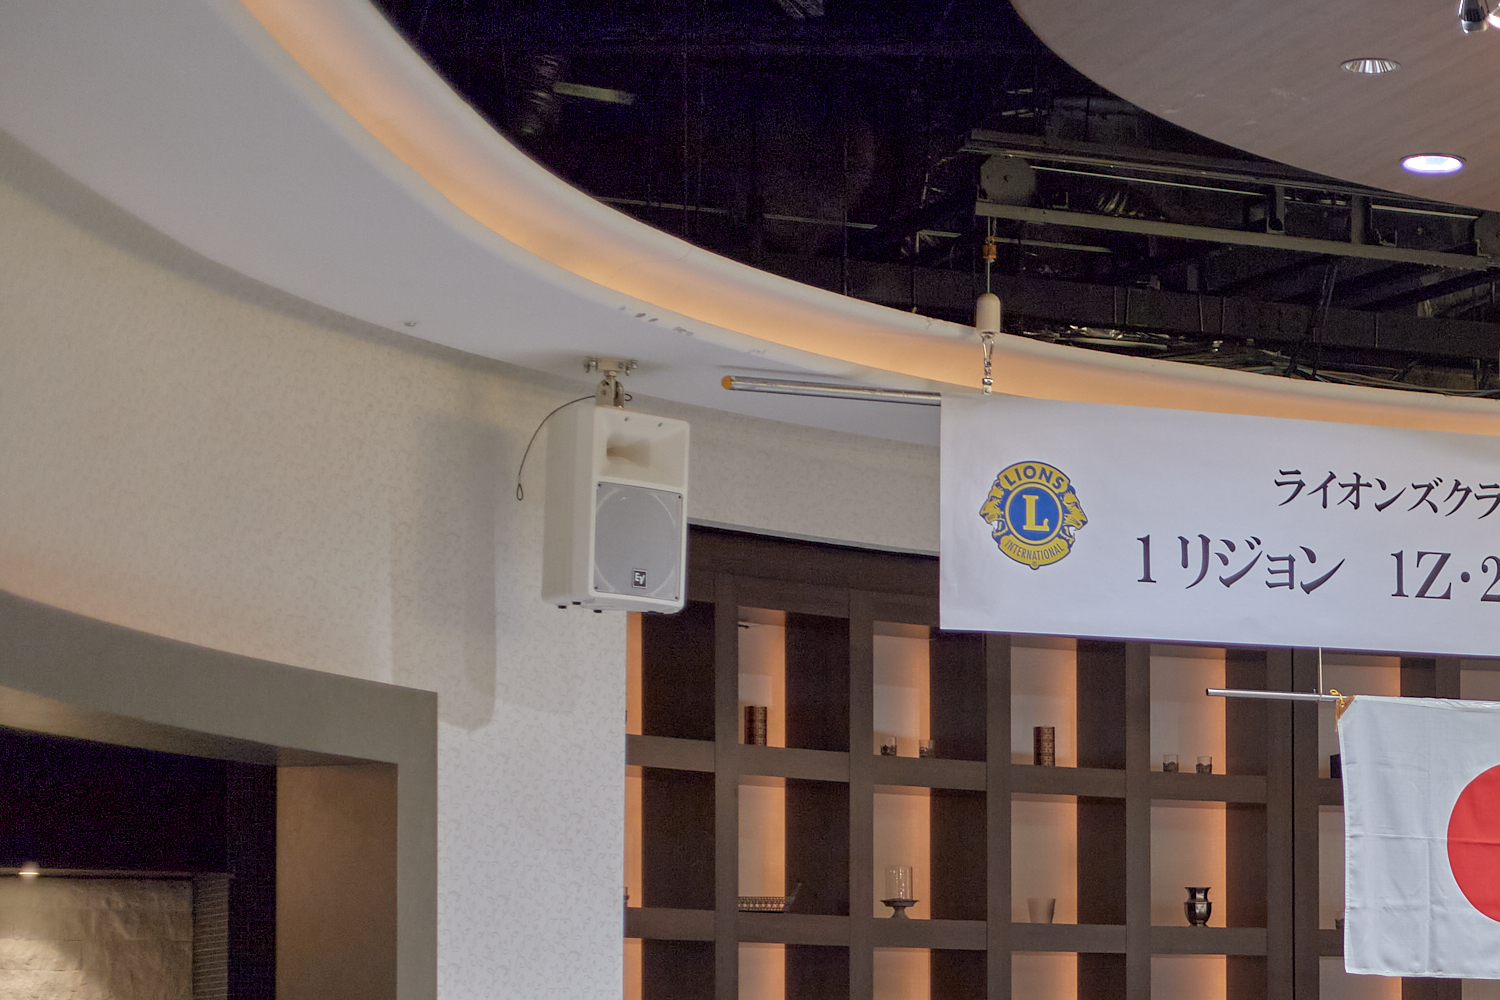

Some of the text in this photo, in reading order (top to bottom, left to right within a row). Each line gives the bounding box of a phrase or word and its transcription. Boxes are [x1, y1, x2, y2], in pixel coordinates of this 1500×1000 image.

[1003, 465, 1065, 490] LIONS
[1022, 494, 1050, 531] L
[1004, 540, 1065, 561] INTERNATIONAL
